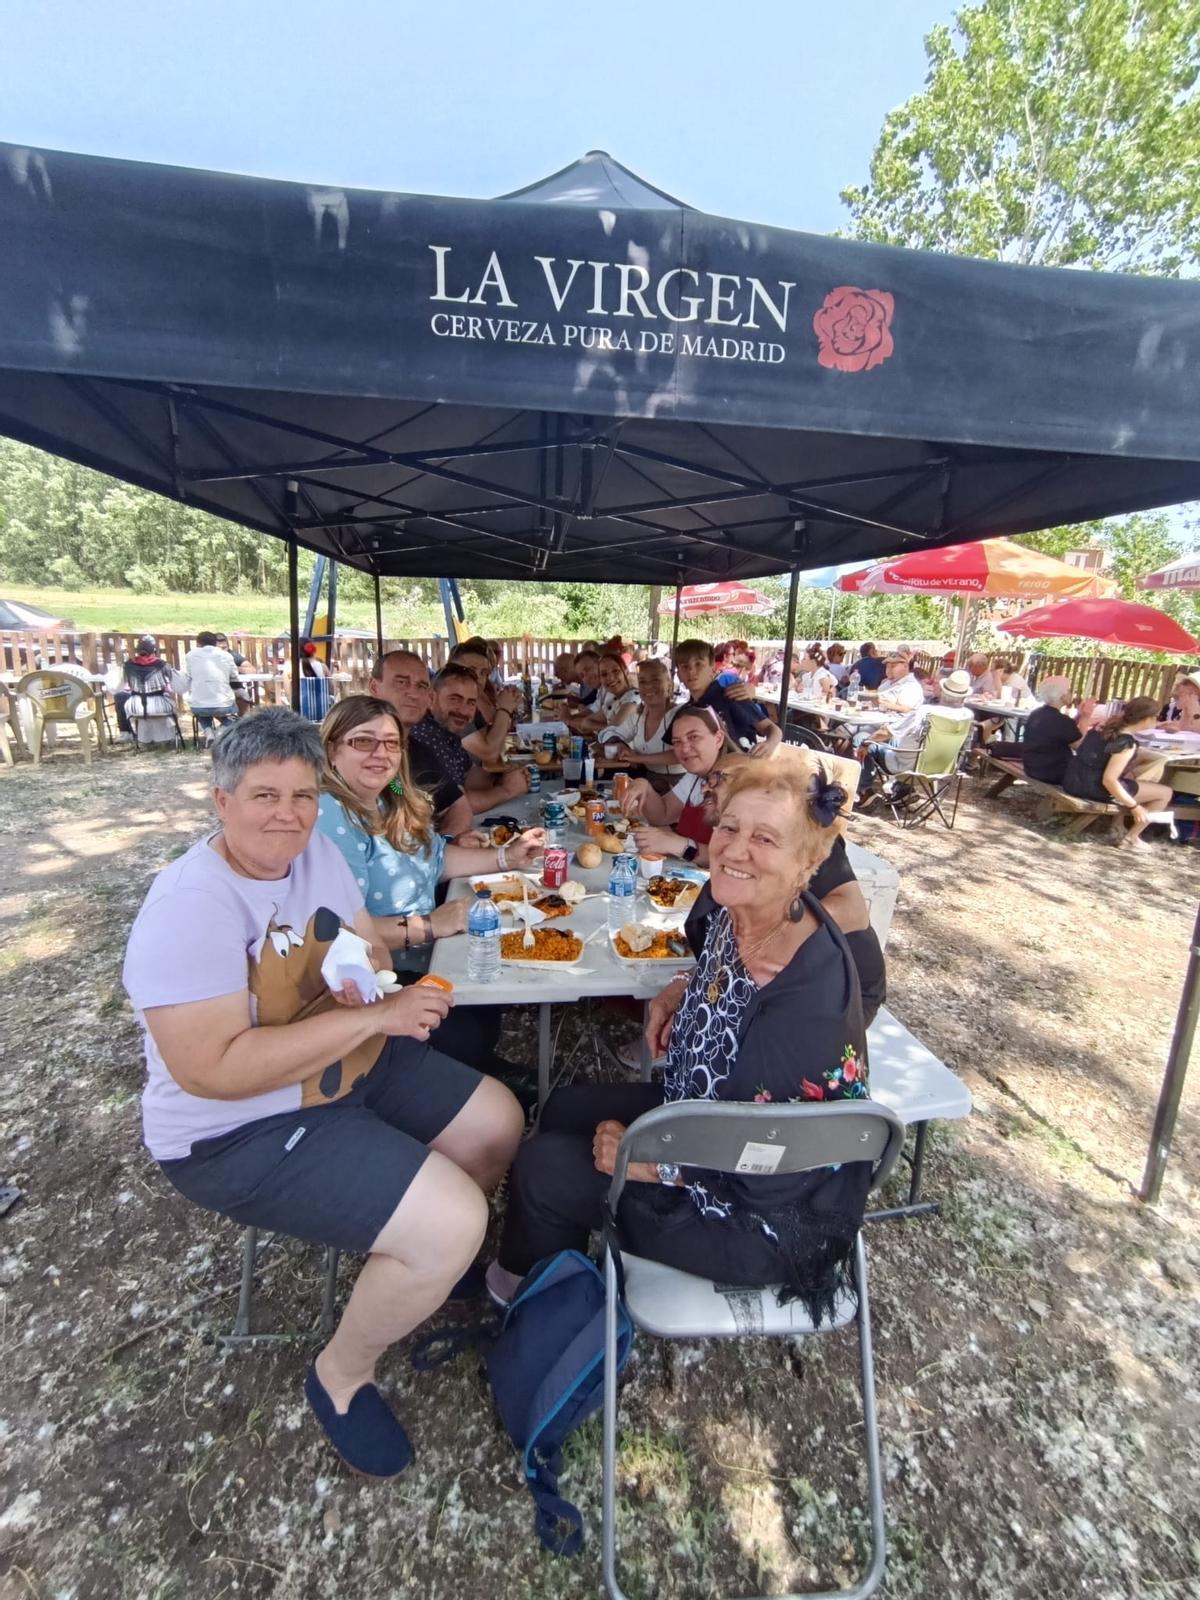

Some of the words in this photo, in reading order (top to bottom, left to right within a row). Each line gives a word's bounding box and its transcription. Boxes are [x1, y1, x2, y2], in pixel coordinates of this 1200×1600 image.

[428, 246, 518, 307] LA
[534, 256, 797, 333] VIRGEN
[431, 313, 556, 345] CERVEZA
[562, 325, 633, 352] PURA
[638, 330, 676, 356] DE
[680, 335, 786, 364] MADRID
